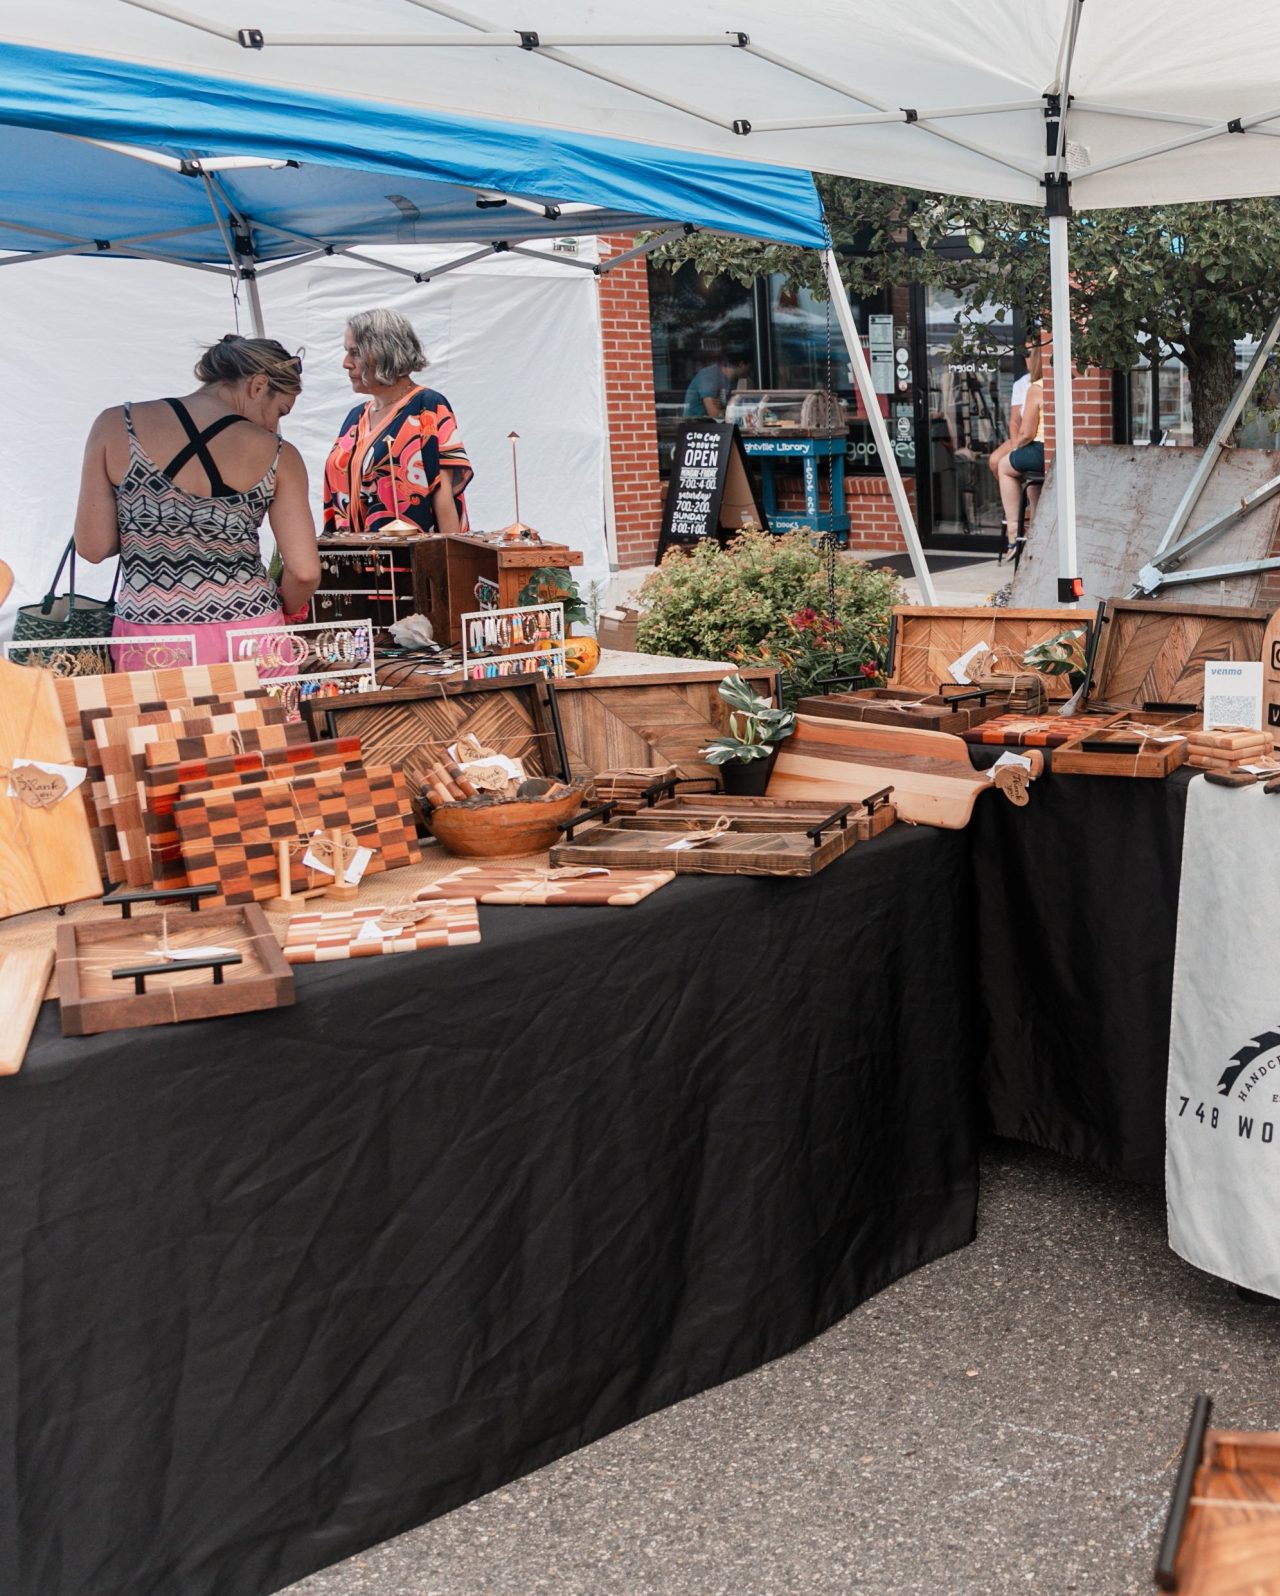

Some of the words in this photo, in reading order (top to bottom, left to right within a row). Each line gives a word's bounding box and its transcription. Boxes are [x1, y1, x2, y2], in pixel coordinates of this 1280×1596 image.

[776, 443, 810, 454] Library
[684, 449, 718, 467] OPEN
[673, 511, 707, 521] SUNDAY
[1211, 668, 1243, 676] venmo
[1179, 1096, 1219, 1129] 748
